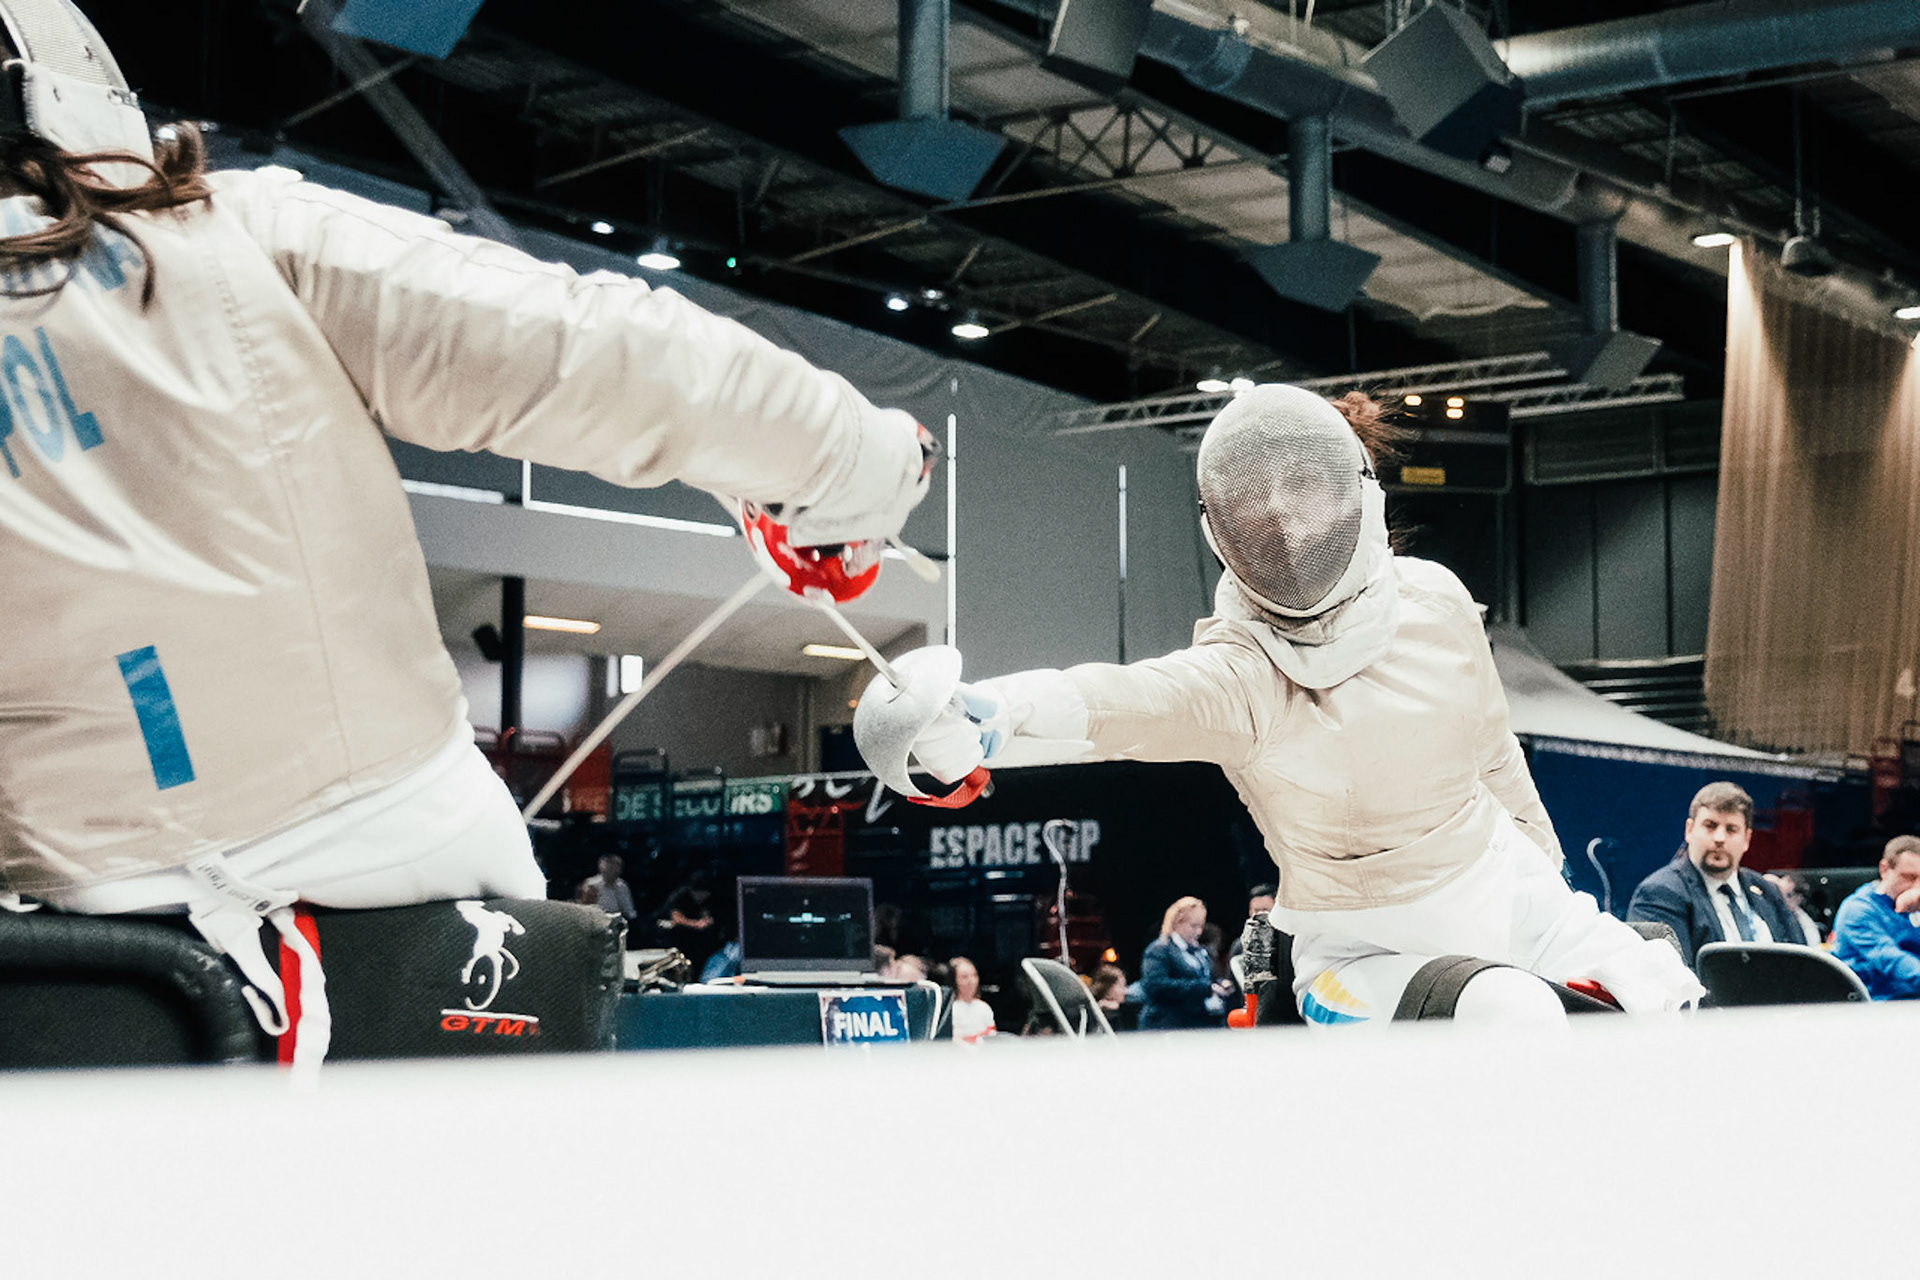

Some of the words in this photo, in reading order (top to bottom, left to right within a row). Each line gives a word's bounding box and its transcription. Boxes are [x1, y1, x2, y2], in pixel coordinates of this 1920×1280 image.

[930, 821, 1042, 869] ESPACE
[440, 1014, 526, 1036] GTM
[833, 1009, 899, 1039] FINAL
